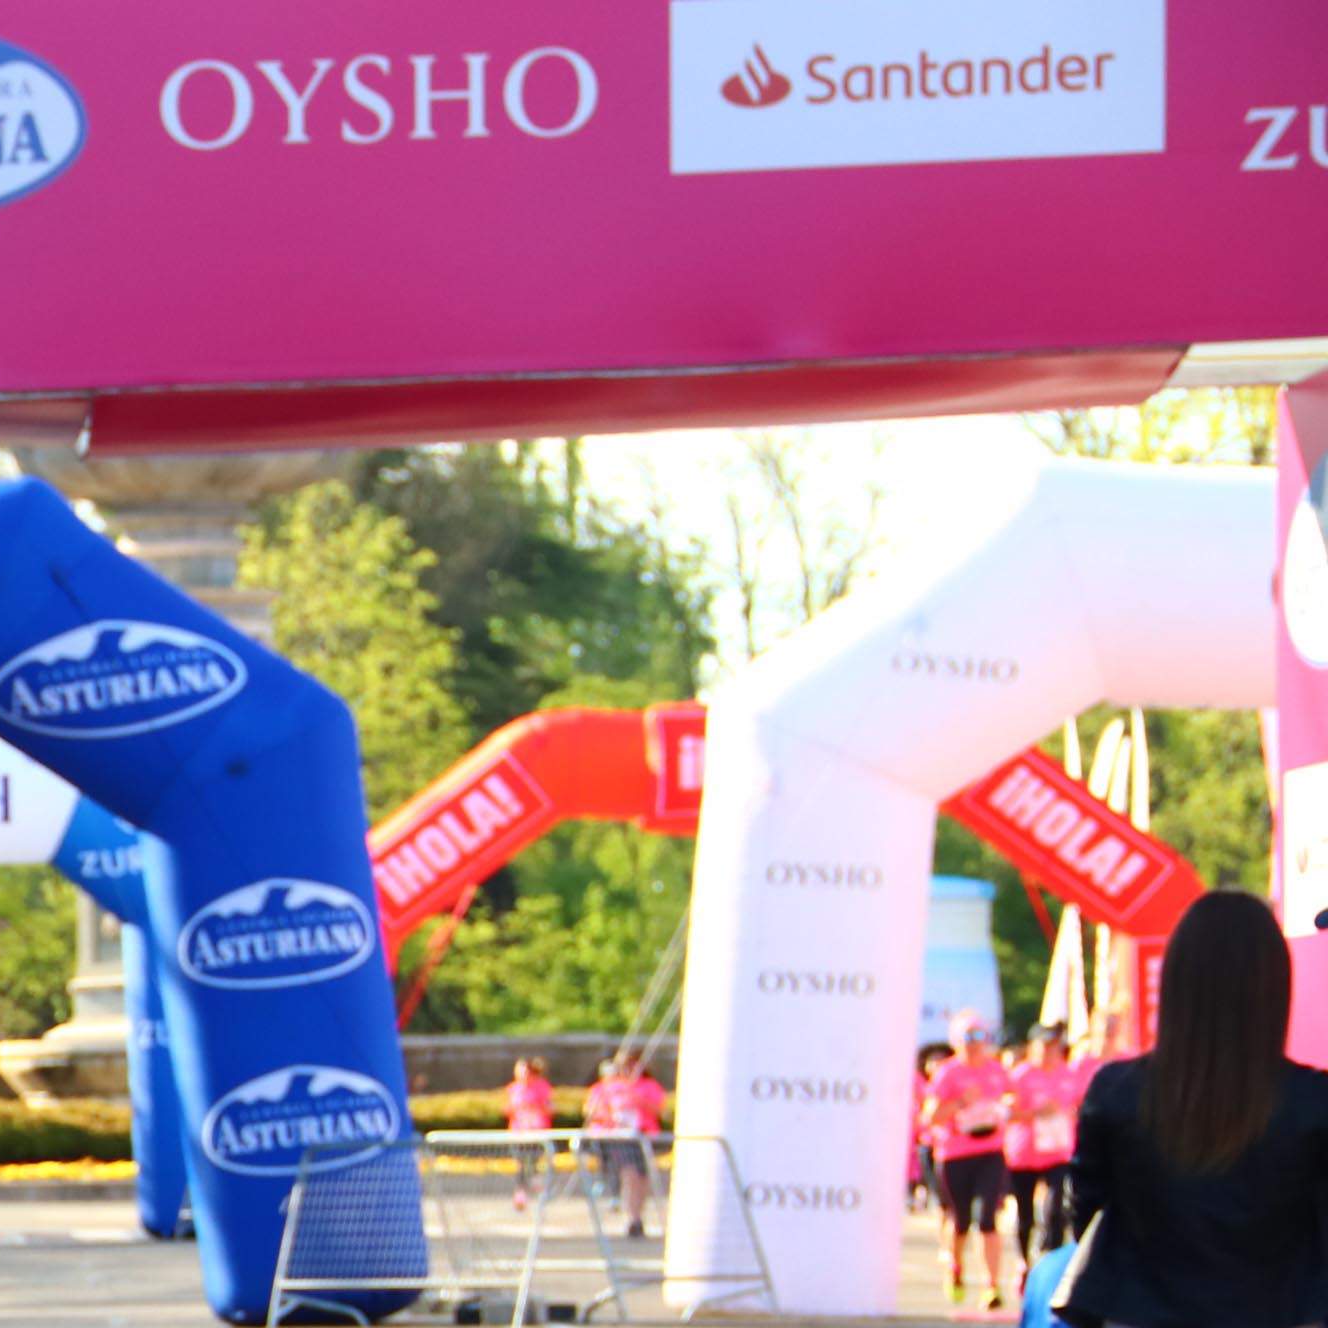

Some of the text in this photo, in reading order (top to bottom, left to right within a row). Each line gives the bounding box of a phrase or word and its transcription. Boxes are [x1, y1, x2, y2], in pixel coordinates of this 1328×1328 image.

[158, 46, 600, 151] OYSHO
[803, 44, 1116, 106] Santander
[9, 660, 230, 718] ASTURIANA
[765, 860, 884, 890] OYSHO
